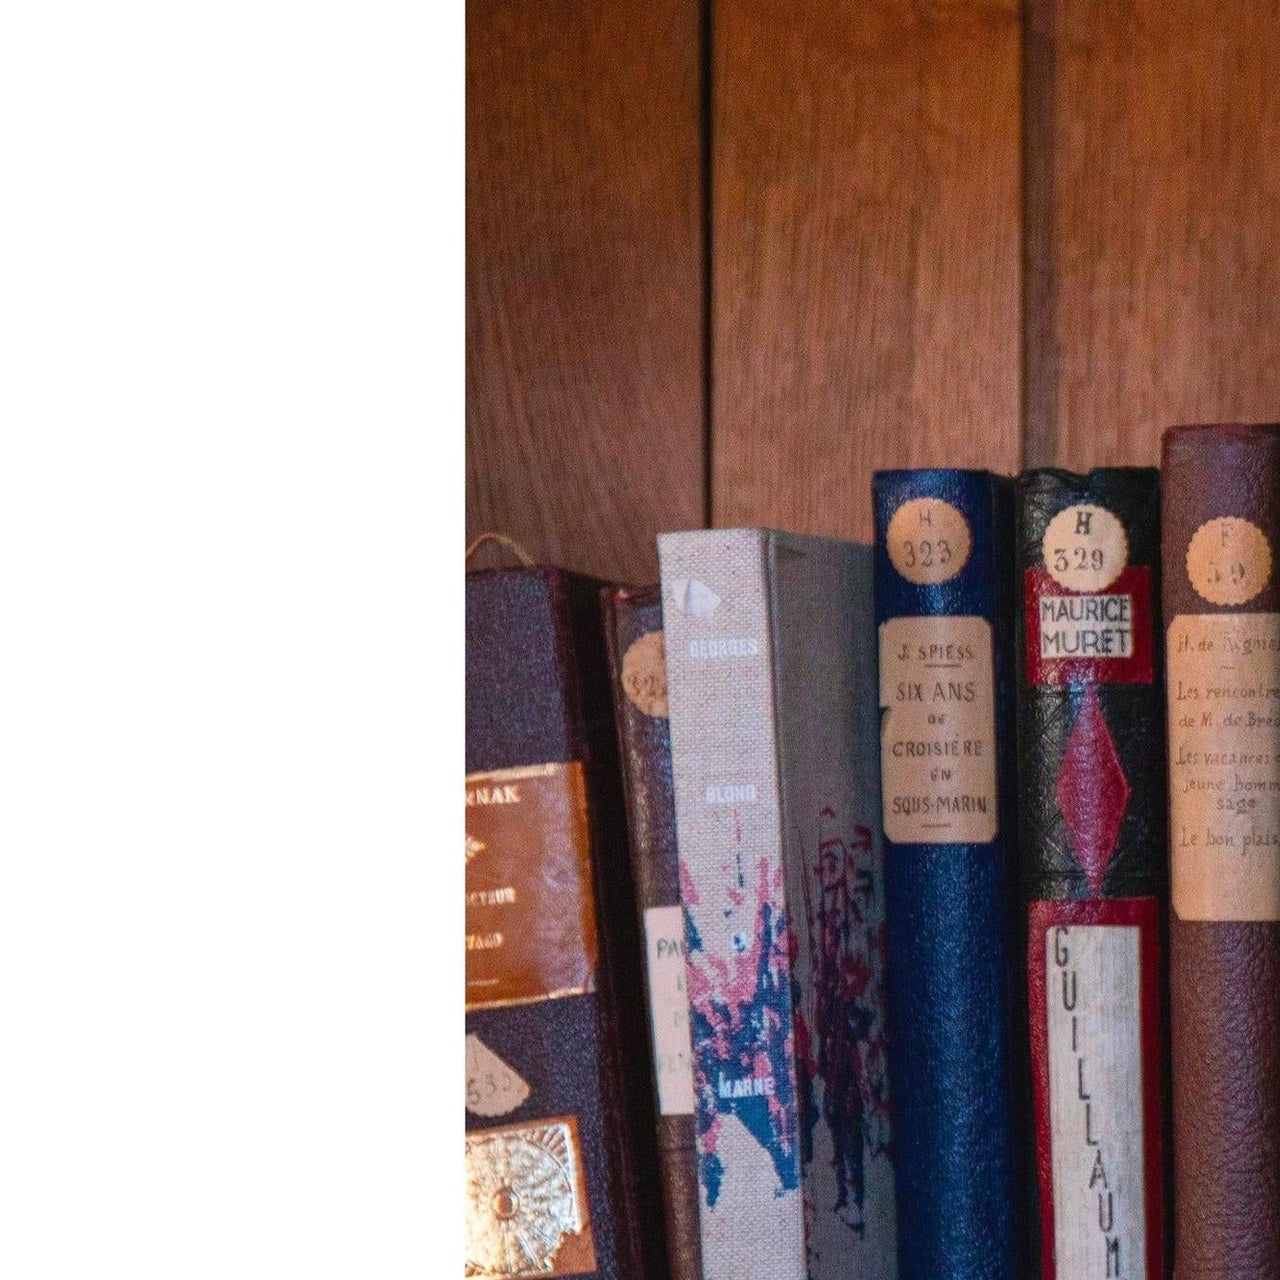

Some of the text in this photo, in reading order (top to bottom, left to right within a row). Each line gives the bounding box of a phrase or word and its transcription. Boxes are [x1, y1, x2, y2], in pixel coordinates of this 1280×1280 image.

[1073, 511, 1094, 536] H
[1053, 548, 1104, 573] 329
[1041, 596, 1130, 623] MAURICE
[918, 643, 974, 661] SPIESS
[1041, 628, 1131, 657] MURET
[895, 681, 975, 703] SIX ANS
[1176, 681, 1199, 701] Les
[1215, 798, 1257, 815] sage
